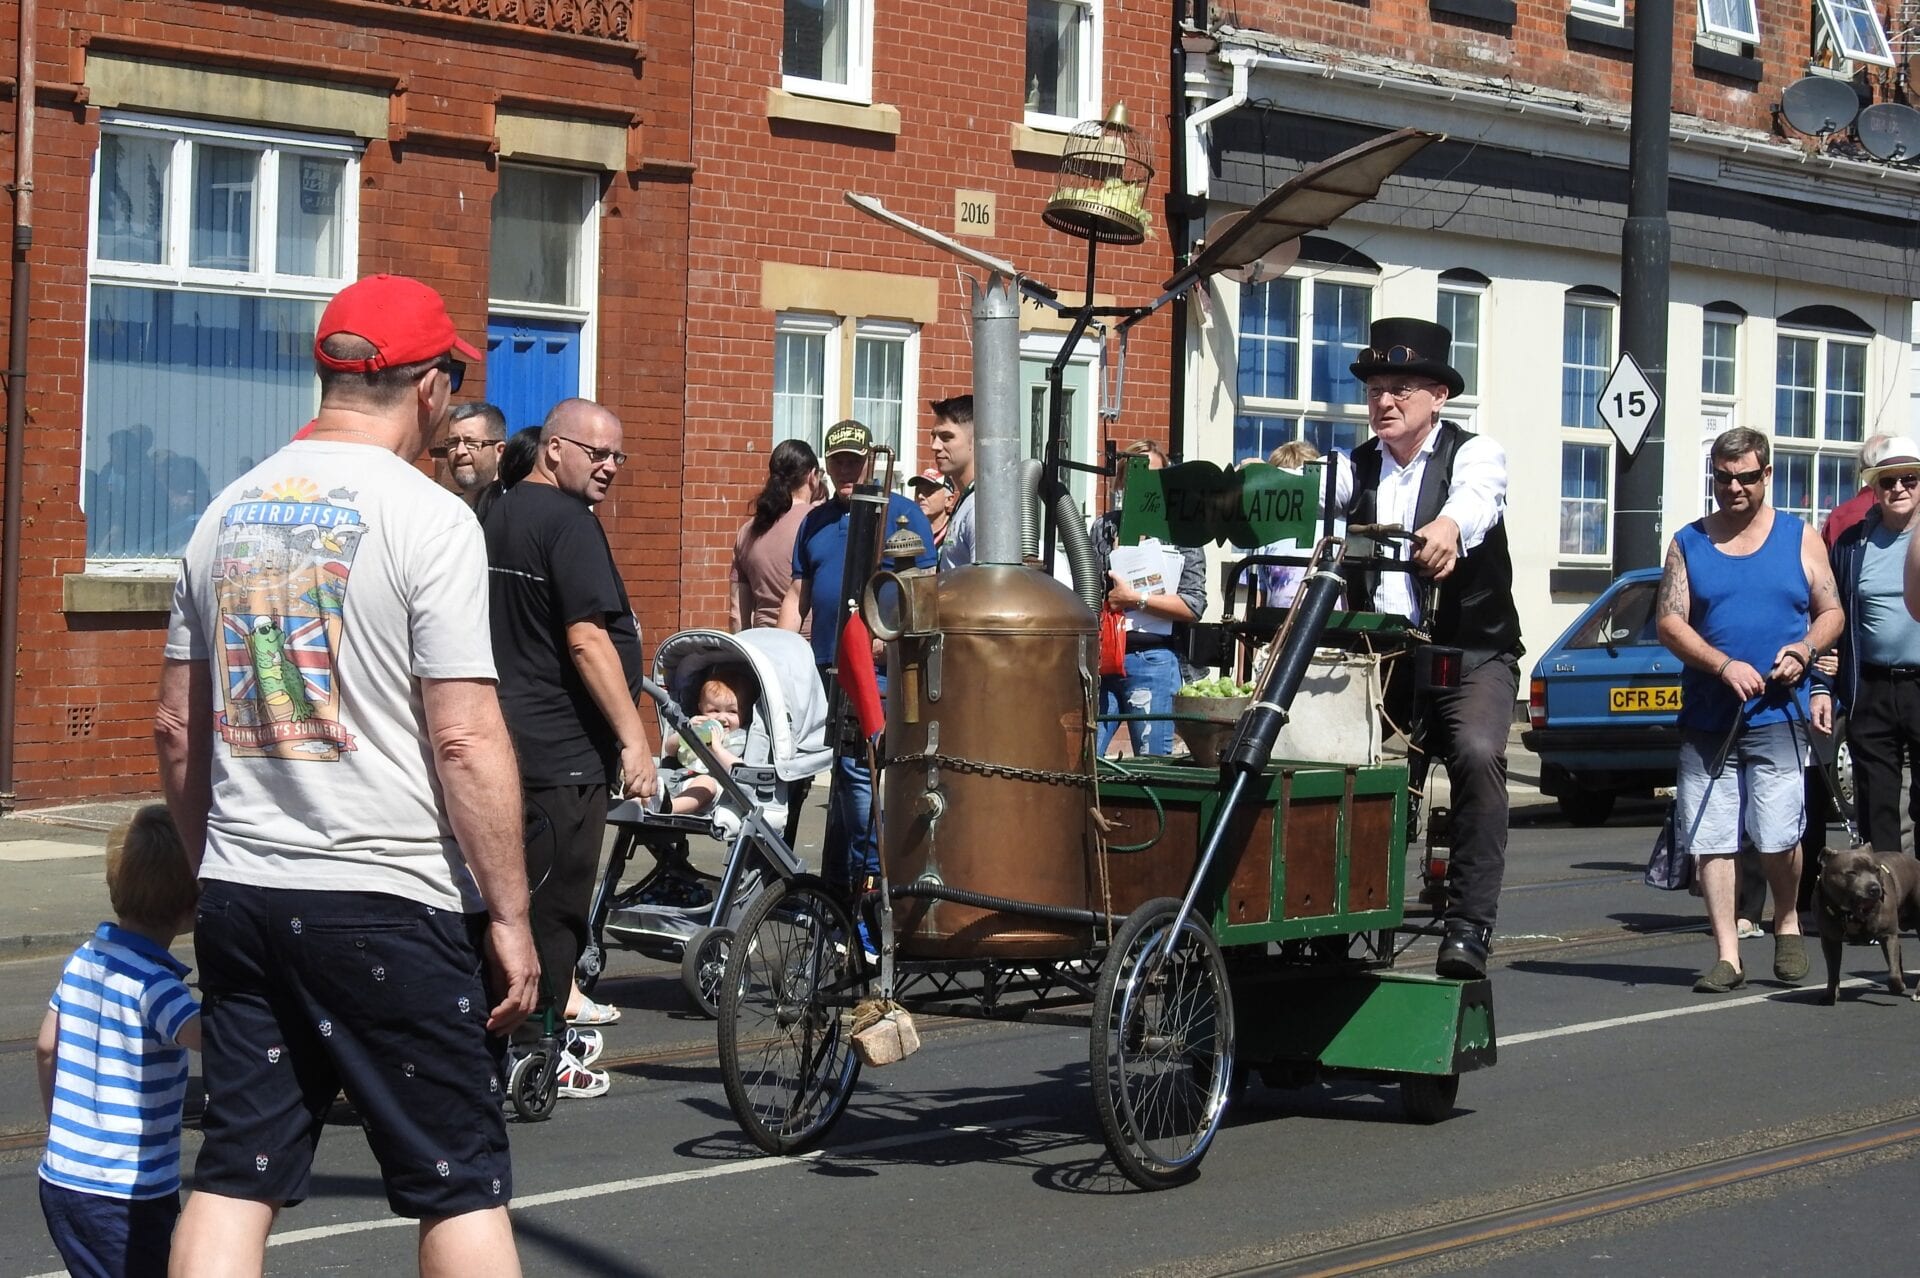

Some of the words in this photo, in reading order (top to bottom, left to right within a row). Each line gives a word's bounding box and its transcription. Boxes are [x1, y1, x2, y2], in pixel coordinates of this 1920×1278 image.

[961, 201, 990, 225] 2016
[1613, 390, 1646, 418] 15
[233, 504, 296, 523] WEIRD
[300, 504, 350, 526] FISH
[1139, 491, 1161, 513] The
[1165, 488, 1304, 522] FLATULATOR
[1613, 691, 1649, 708] CFR
[1655, 690, 1684, 707] 54
